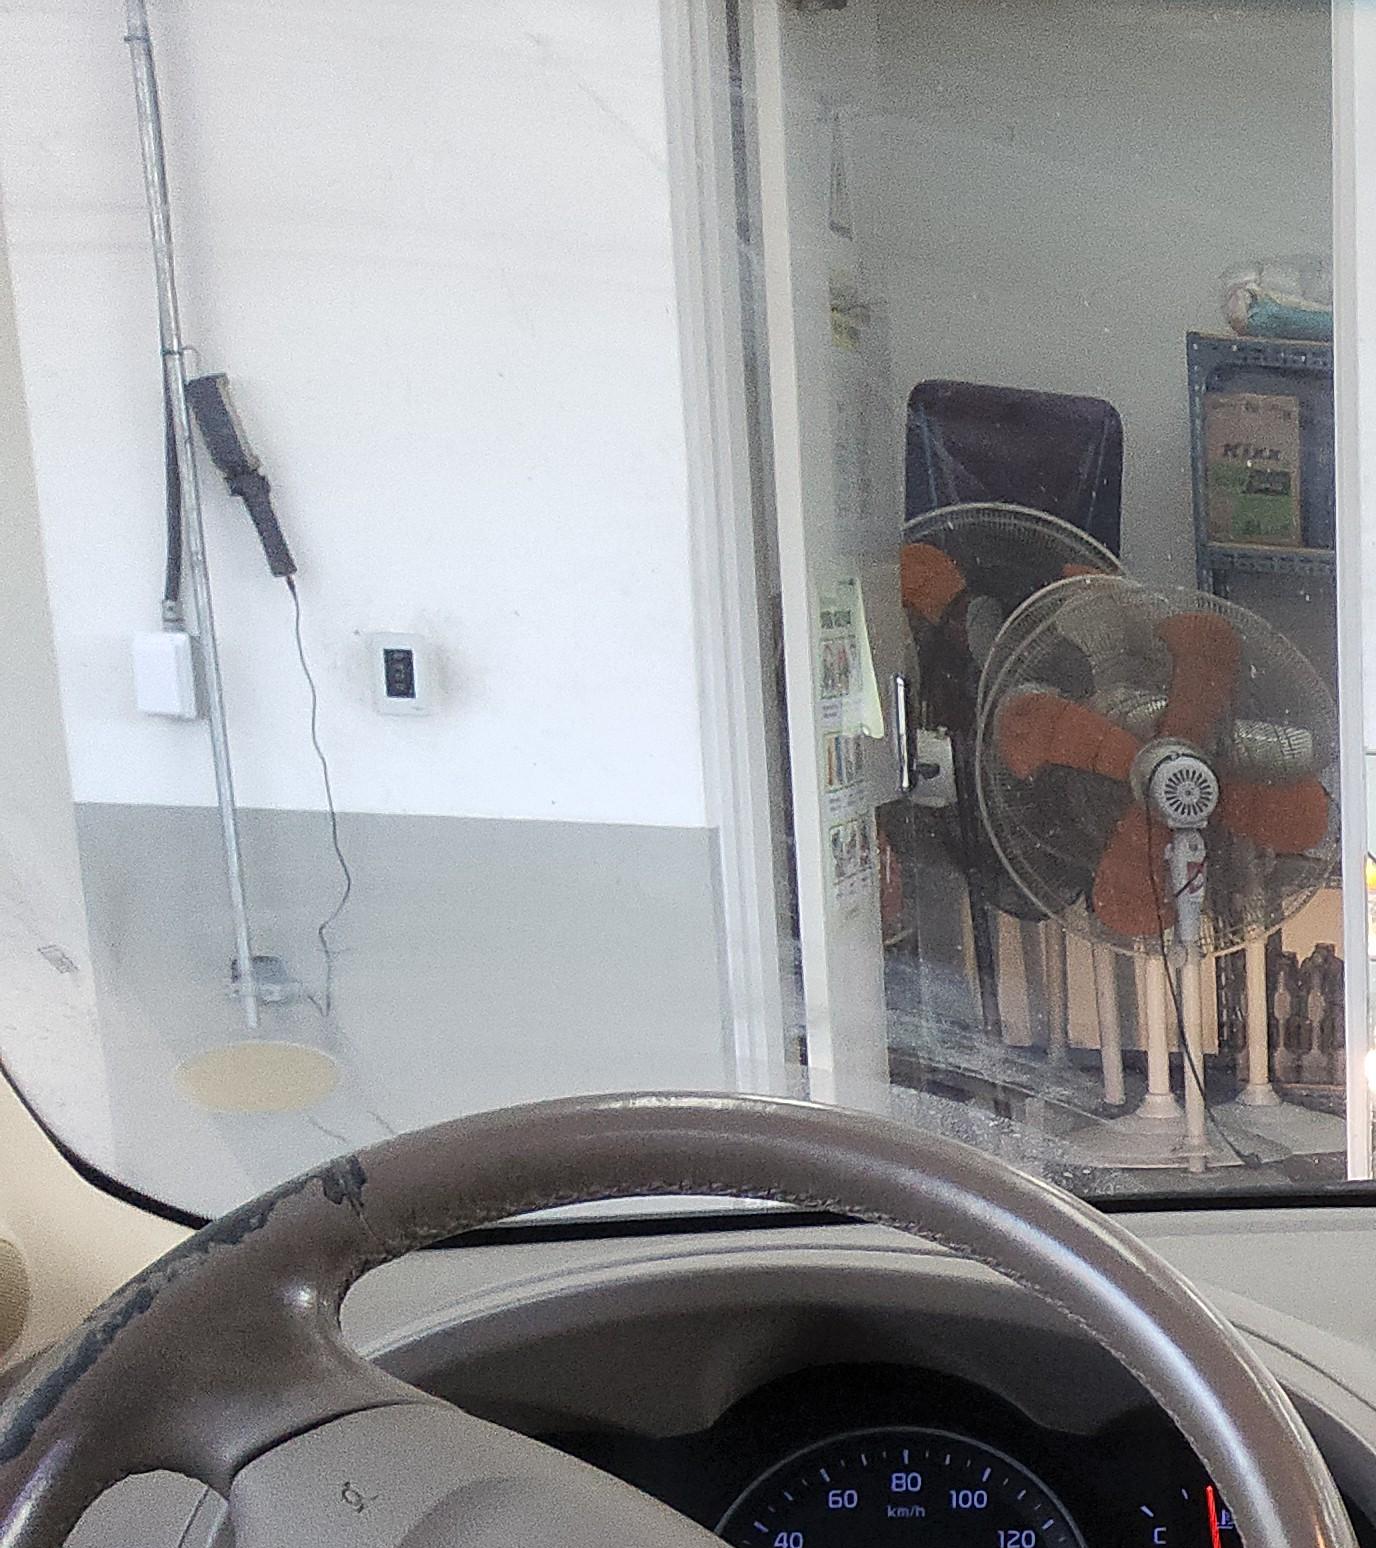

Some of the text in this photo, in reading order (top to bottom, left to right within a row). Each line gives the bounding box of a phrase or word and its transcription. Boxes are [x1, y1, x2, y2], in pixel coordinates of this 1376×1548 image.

[891, 1472, 922, 1493] 80
[828, 1489, 858, 1510] 60
[948, 1489, 988, 1510] 100
[886, 1504, 926, 1519] km/h
[1153, 1527, 1167, 1545] C
